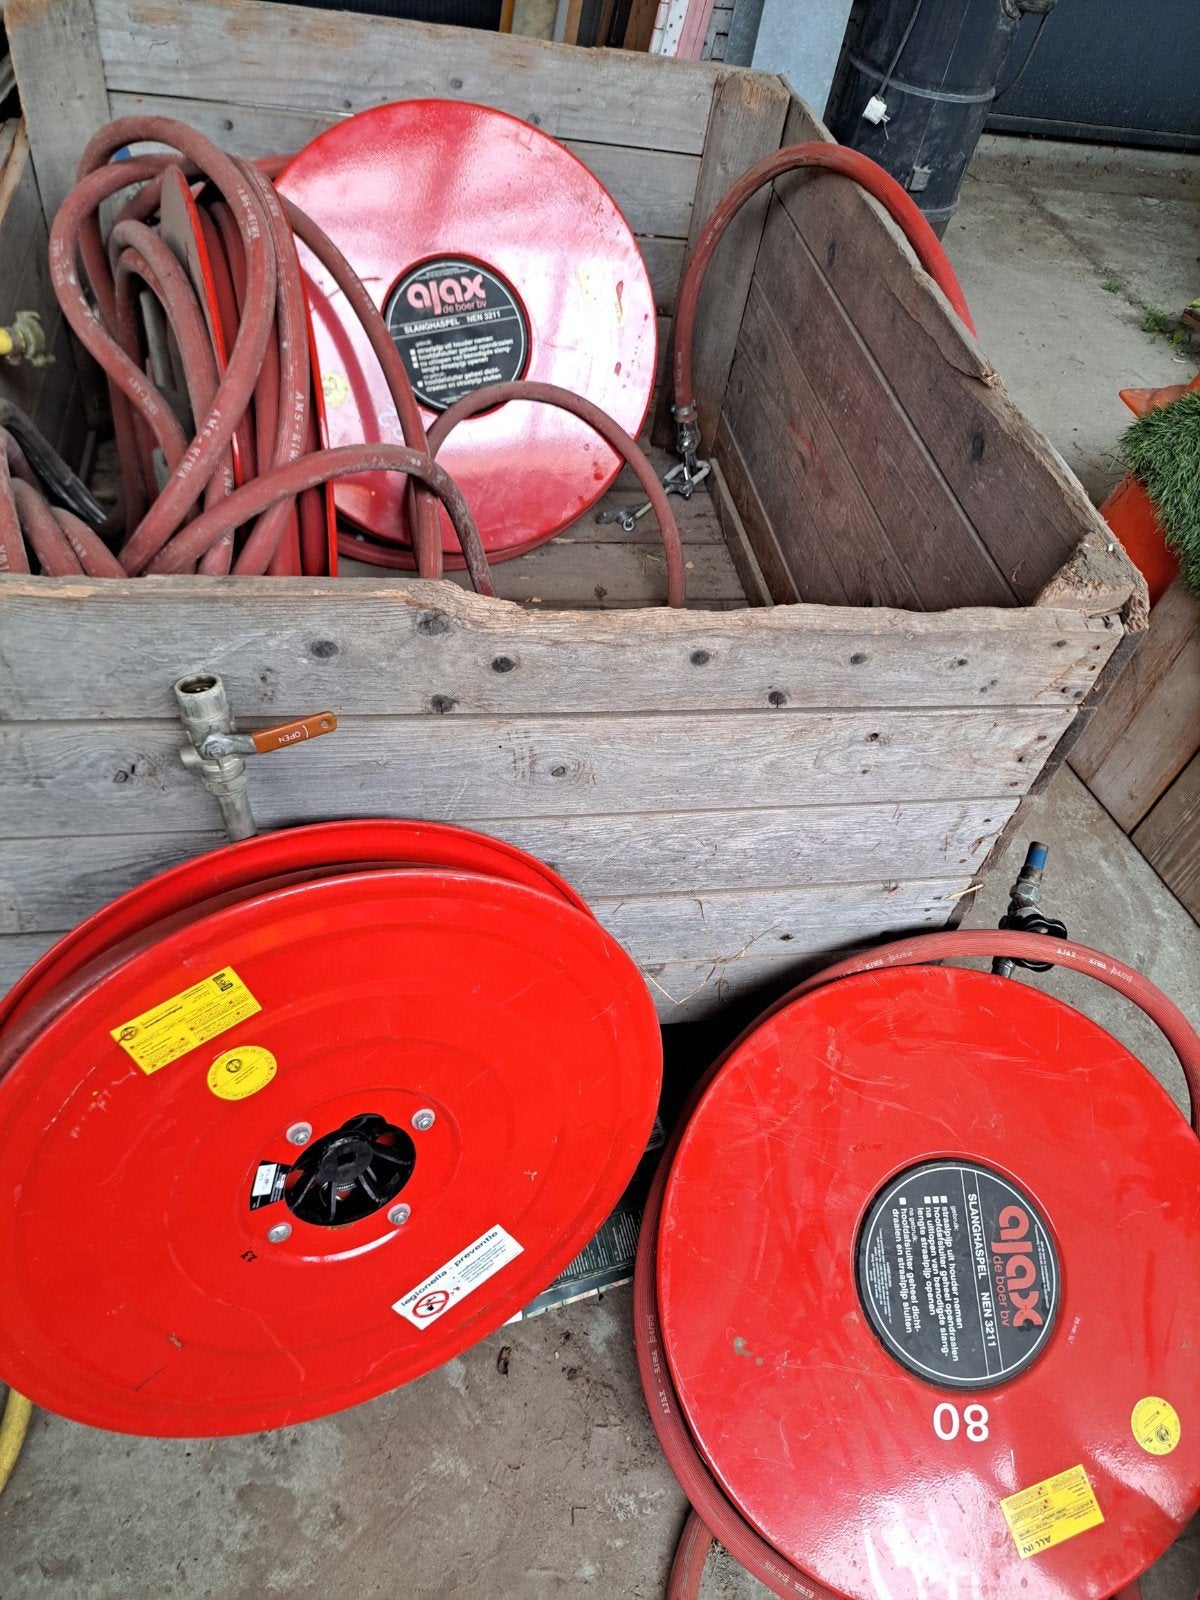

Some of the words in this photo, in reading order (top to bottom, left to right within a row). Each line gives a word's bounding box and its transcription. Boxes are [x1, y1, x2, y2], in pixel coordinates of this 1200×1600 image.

[407, 274, 486, 315] ajax
[404, 318, 460, 334] SLANGHASPEL
[466, 314, 483, 323] NEN
[288, 391, 304, 461] AMS-KIW
[278, 731, 301, 743] OPEN
[968, 1193, 988, 1279] SLANGHASPEL
[400, 1270, 447, 1307] legionella
[454, 1231, 498, 1267] preventie
[991, 1205, 1043, 1327] ajax
[993, 1255, 1005, 1272] de
[981, 1292, 993, 1317] NEN
[996, 1276, 1008, 1306] boer
[1000, 1311, 1011, 1326] bv
[985, 1320, 997, 1347] 3211
